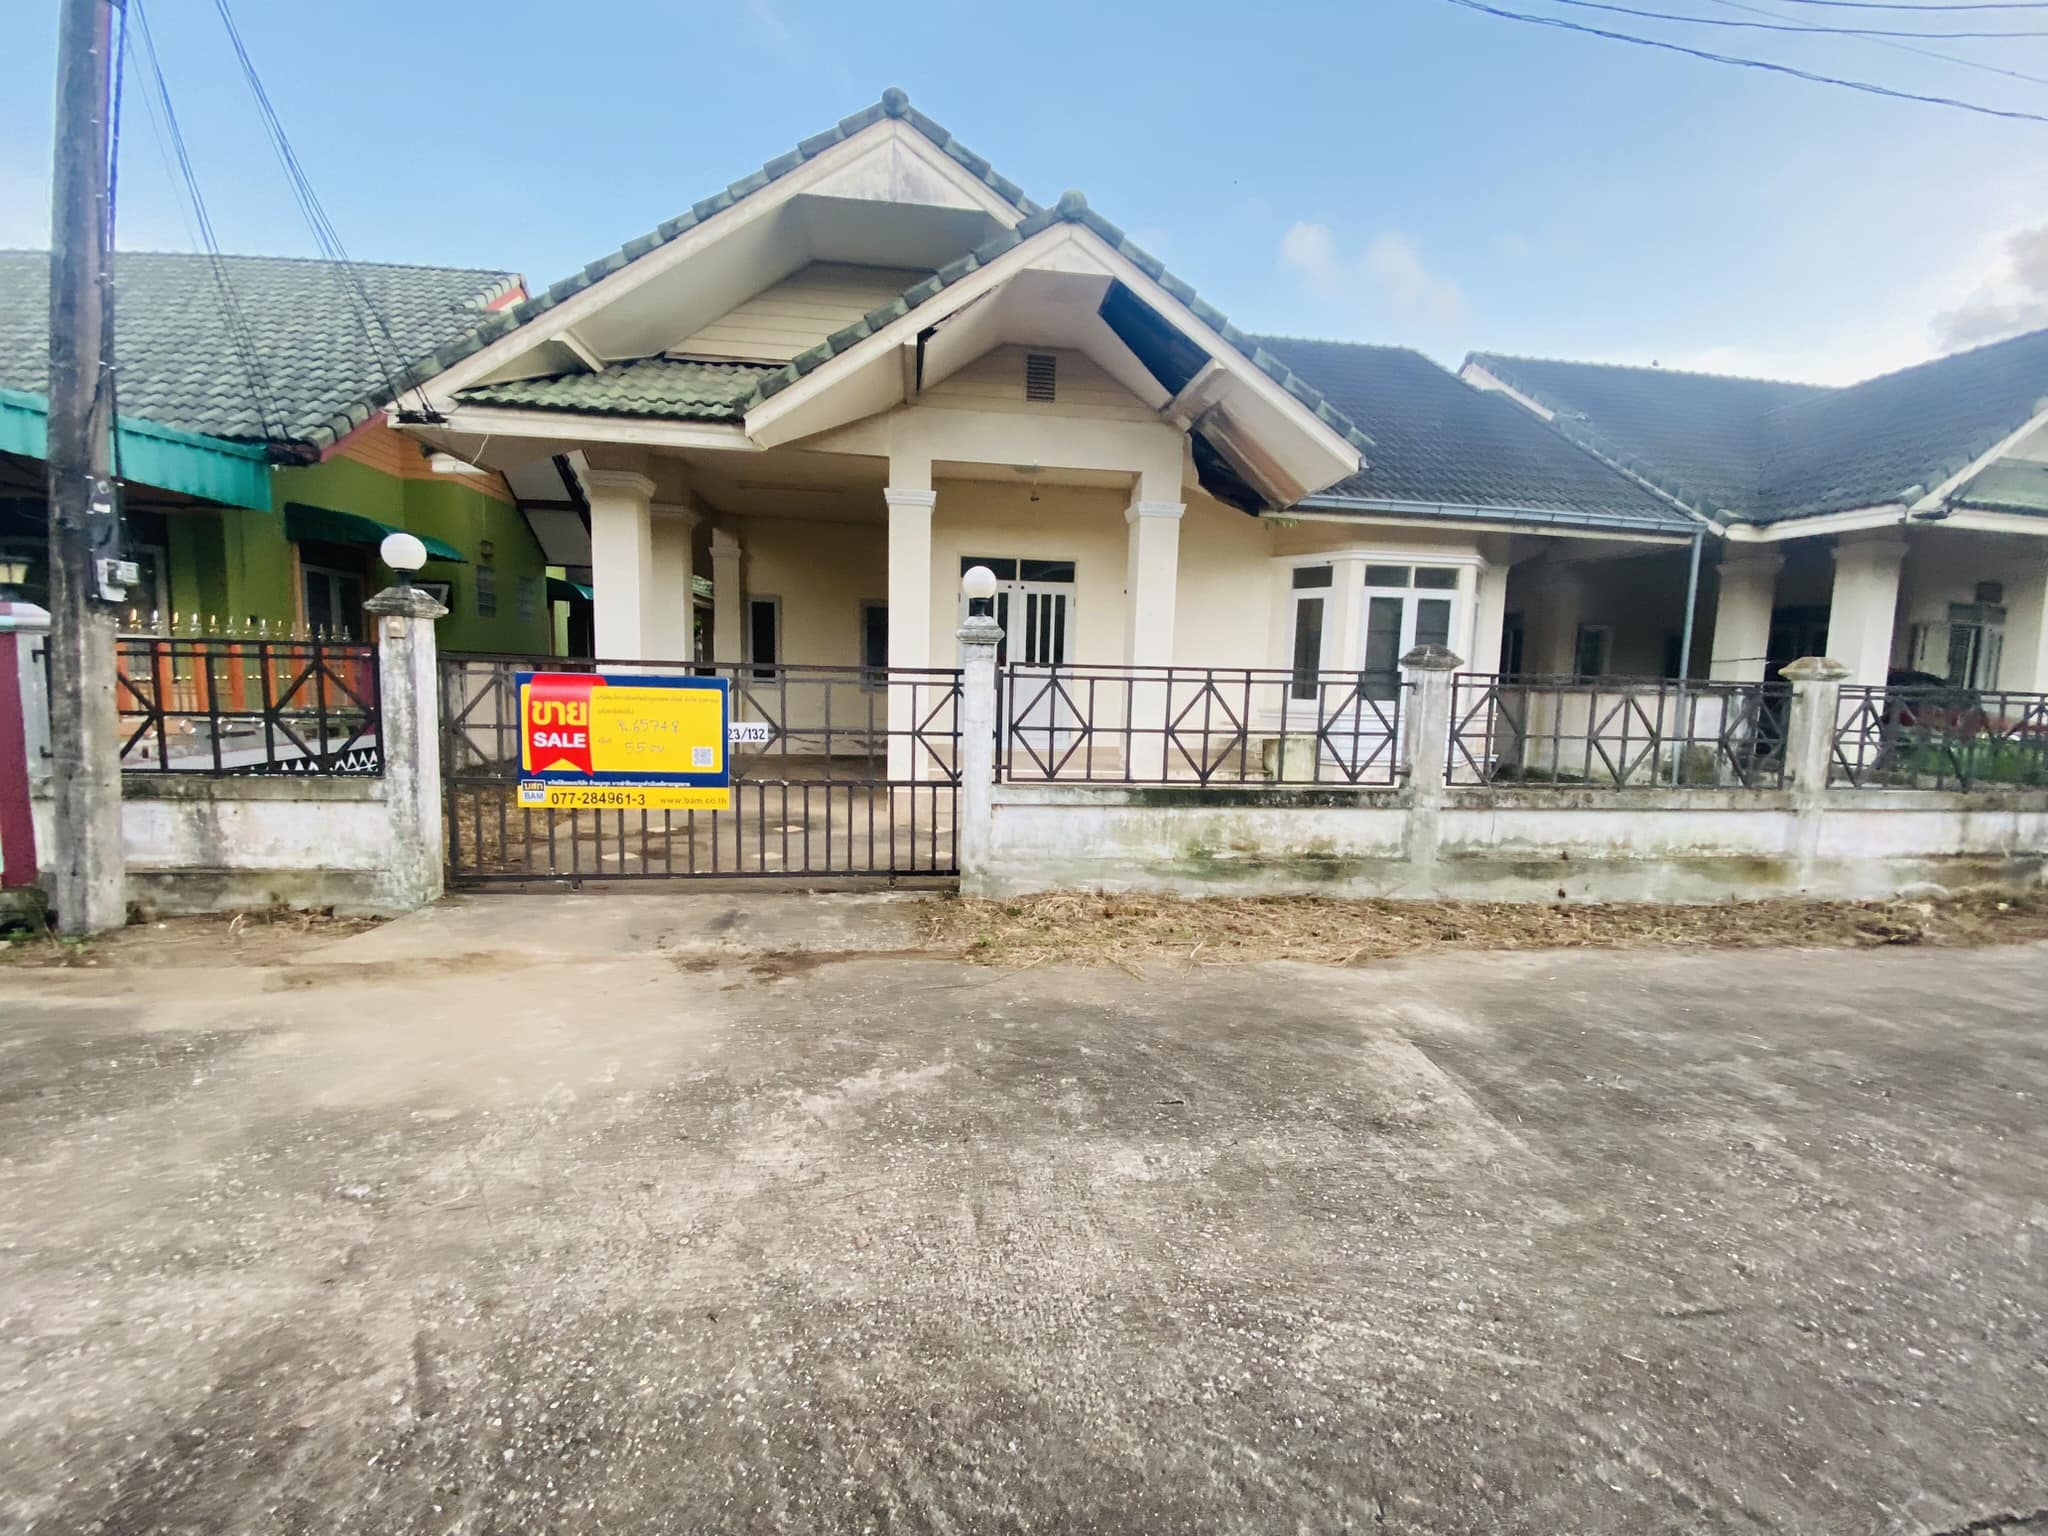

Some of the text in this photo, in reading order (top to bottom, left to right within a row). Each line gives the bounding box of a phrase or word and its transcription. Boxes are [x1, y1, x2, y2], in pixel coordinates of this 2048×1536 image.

[532, 700, 587, 725] ขาย
[533, 732, 587, 748] SALE
[524, 791, 545, 801] BAM
[551, 792, 646, 806] 077-284961-3
[659, 796, 727, 806] www.bam.co.th
